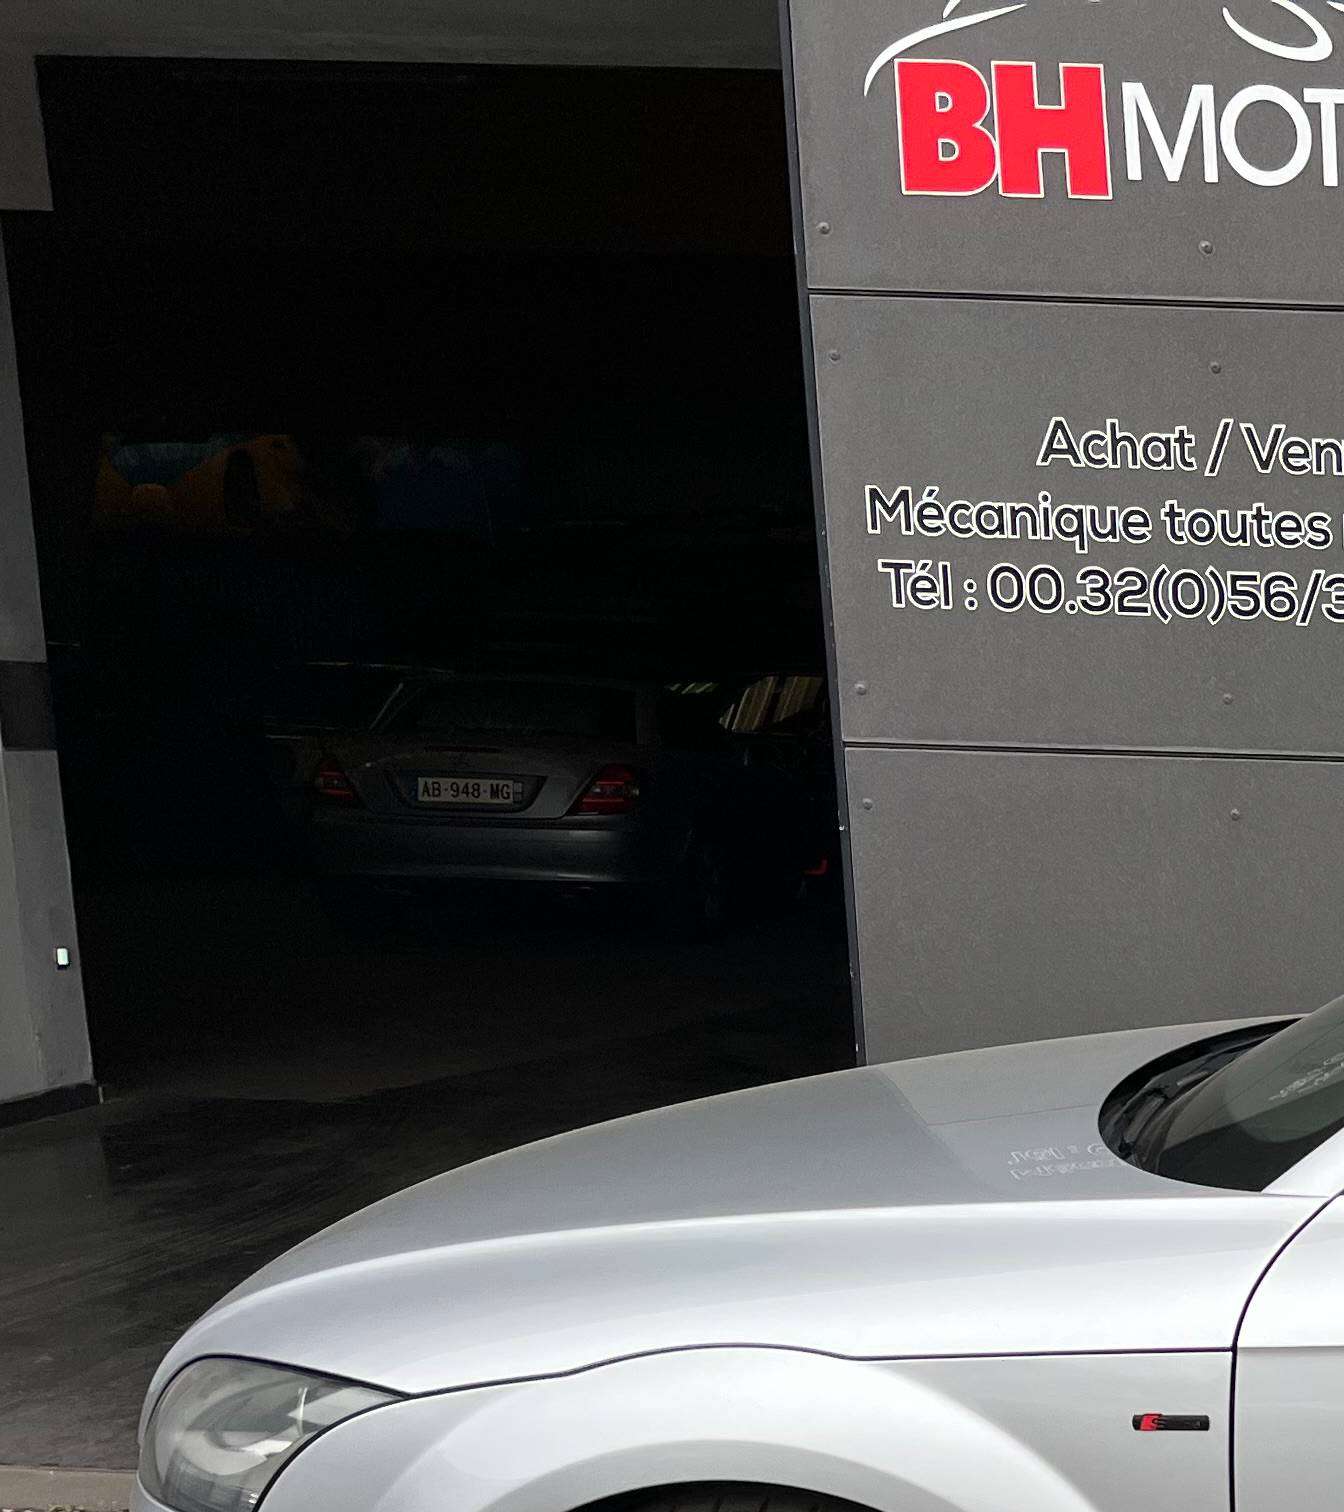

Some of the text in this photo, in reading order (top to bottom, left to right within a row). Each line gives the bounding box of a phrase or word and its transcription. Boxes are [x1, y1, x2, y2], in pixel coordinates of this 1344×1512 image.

[893, 57, 1113, 200] BH
[1036, 417, 1198, 471] Achat
[1204, 418, 1234, 477] /
[863, 486, 1152, 554] Mécanique
[1160, 498, 1333, 551] toutes
[878, 561, 953, 611] Tél
[962, 576, 978, 611] :
